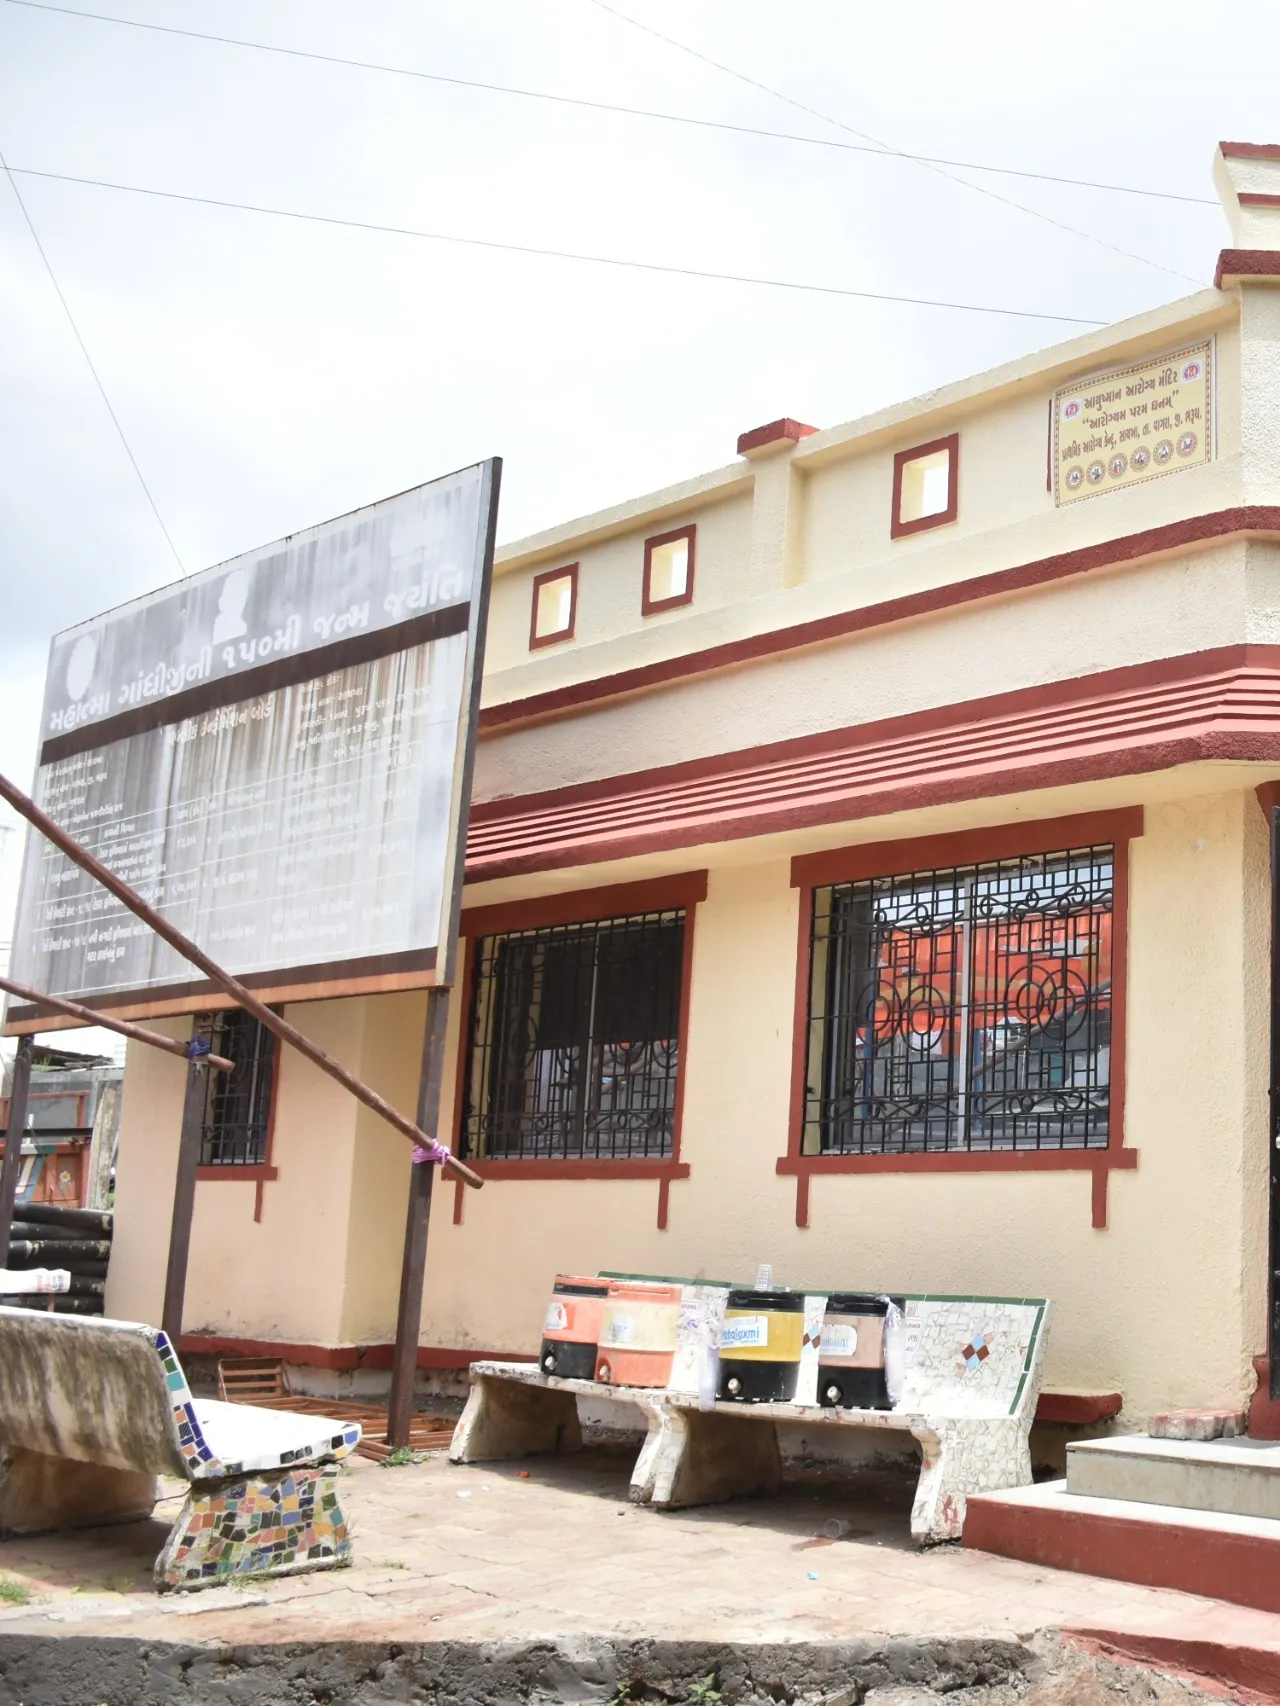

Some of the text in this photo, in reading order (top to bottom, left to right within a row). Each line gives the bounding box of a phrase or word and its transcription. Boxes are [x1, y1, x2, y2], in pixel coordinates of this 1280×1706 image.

[1125, 377, 1155, 397] આરોગ્ય
[1158, 368, 1178, 387] મંદિર
[1130, 403, 1148, 417] પરમ
[50, 691, 110, 731] મહાત્મા
[117, 644, 212, 704] ગાંધીજીની
[221, 614, 300, 669] ૧૫૦મી
[313, 602, 369, 639] જન્મ
